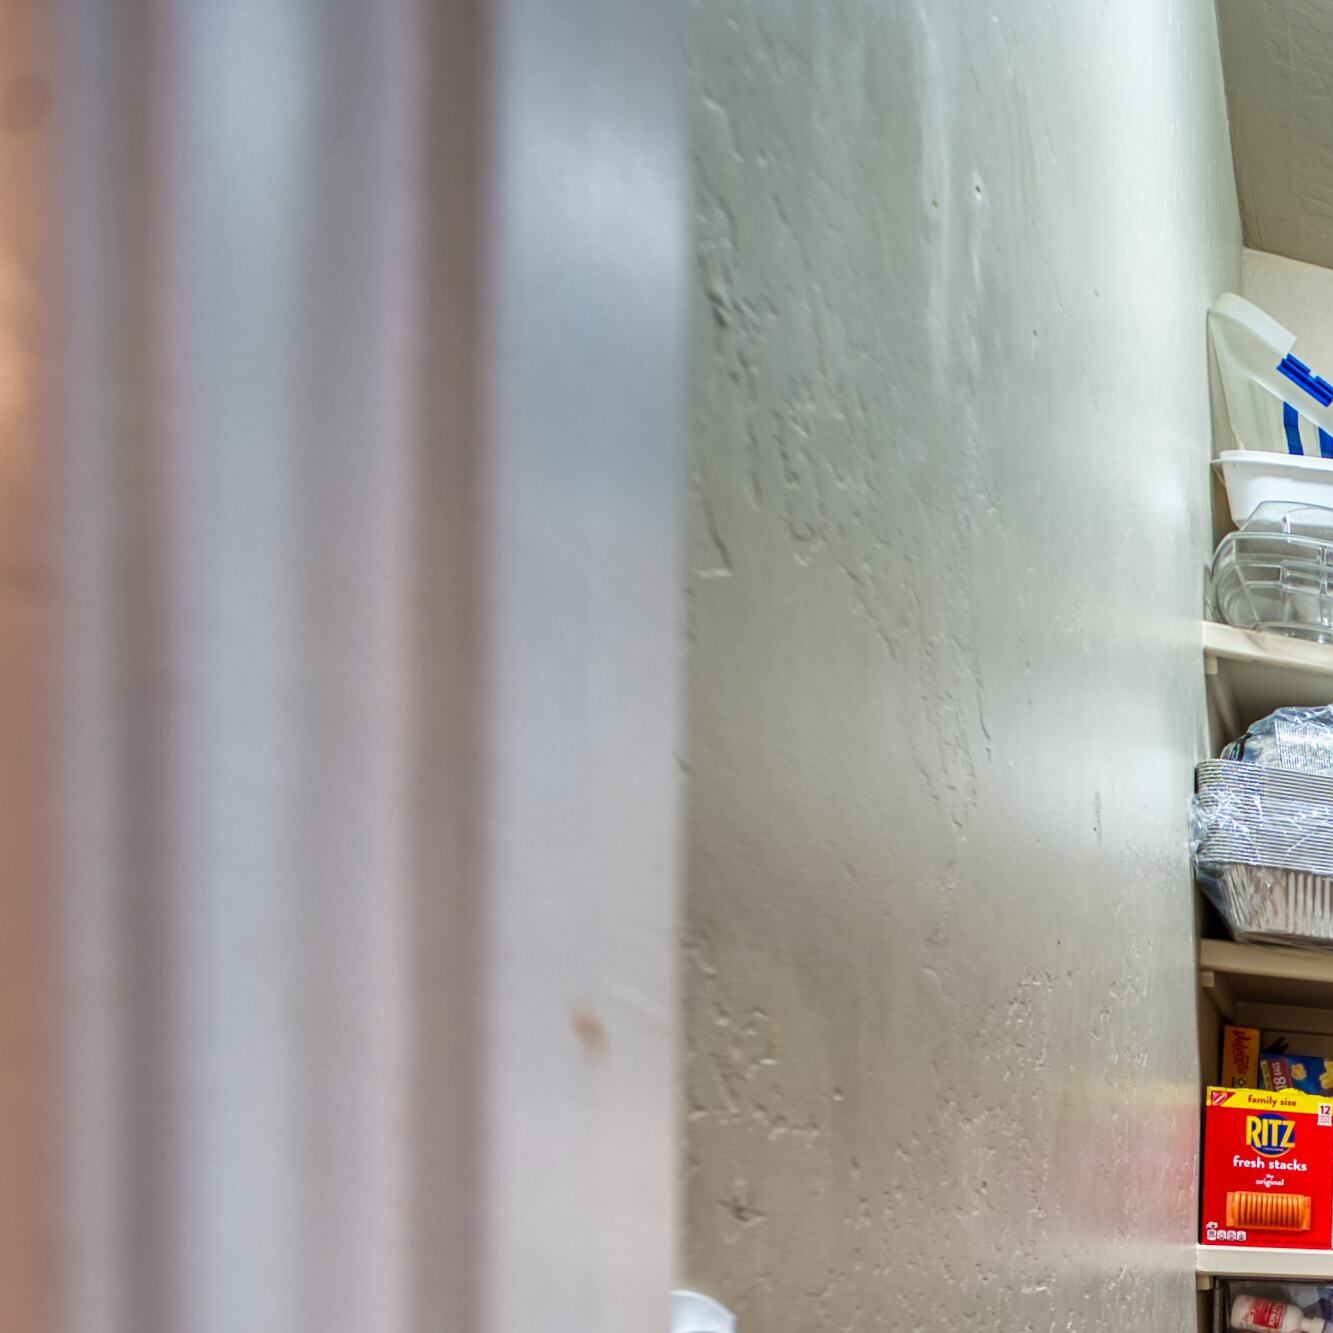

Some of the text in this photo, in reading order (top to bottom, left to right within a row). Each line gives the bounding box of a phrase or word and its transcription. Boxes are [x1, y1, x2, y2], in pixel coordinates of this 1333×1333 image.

[1247, 1094, 1297, 1108] family size
[1319, 1104, 1331, 1115] 12
[1246, 1114, 1296, 1148] RITZ
[1233, 1155, 1308, 1172] fresh stacks
[1255, 1177, 1285, 1188] original
